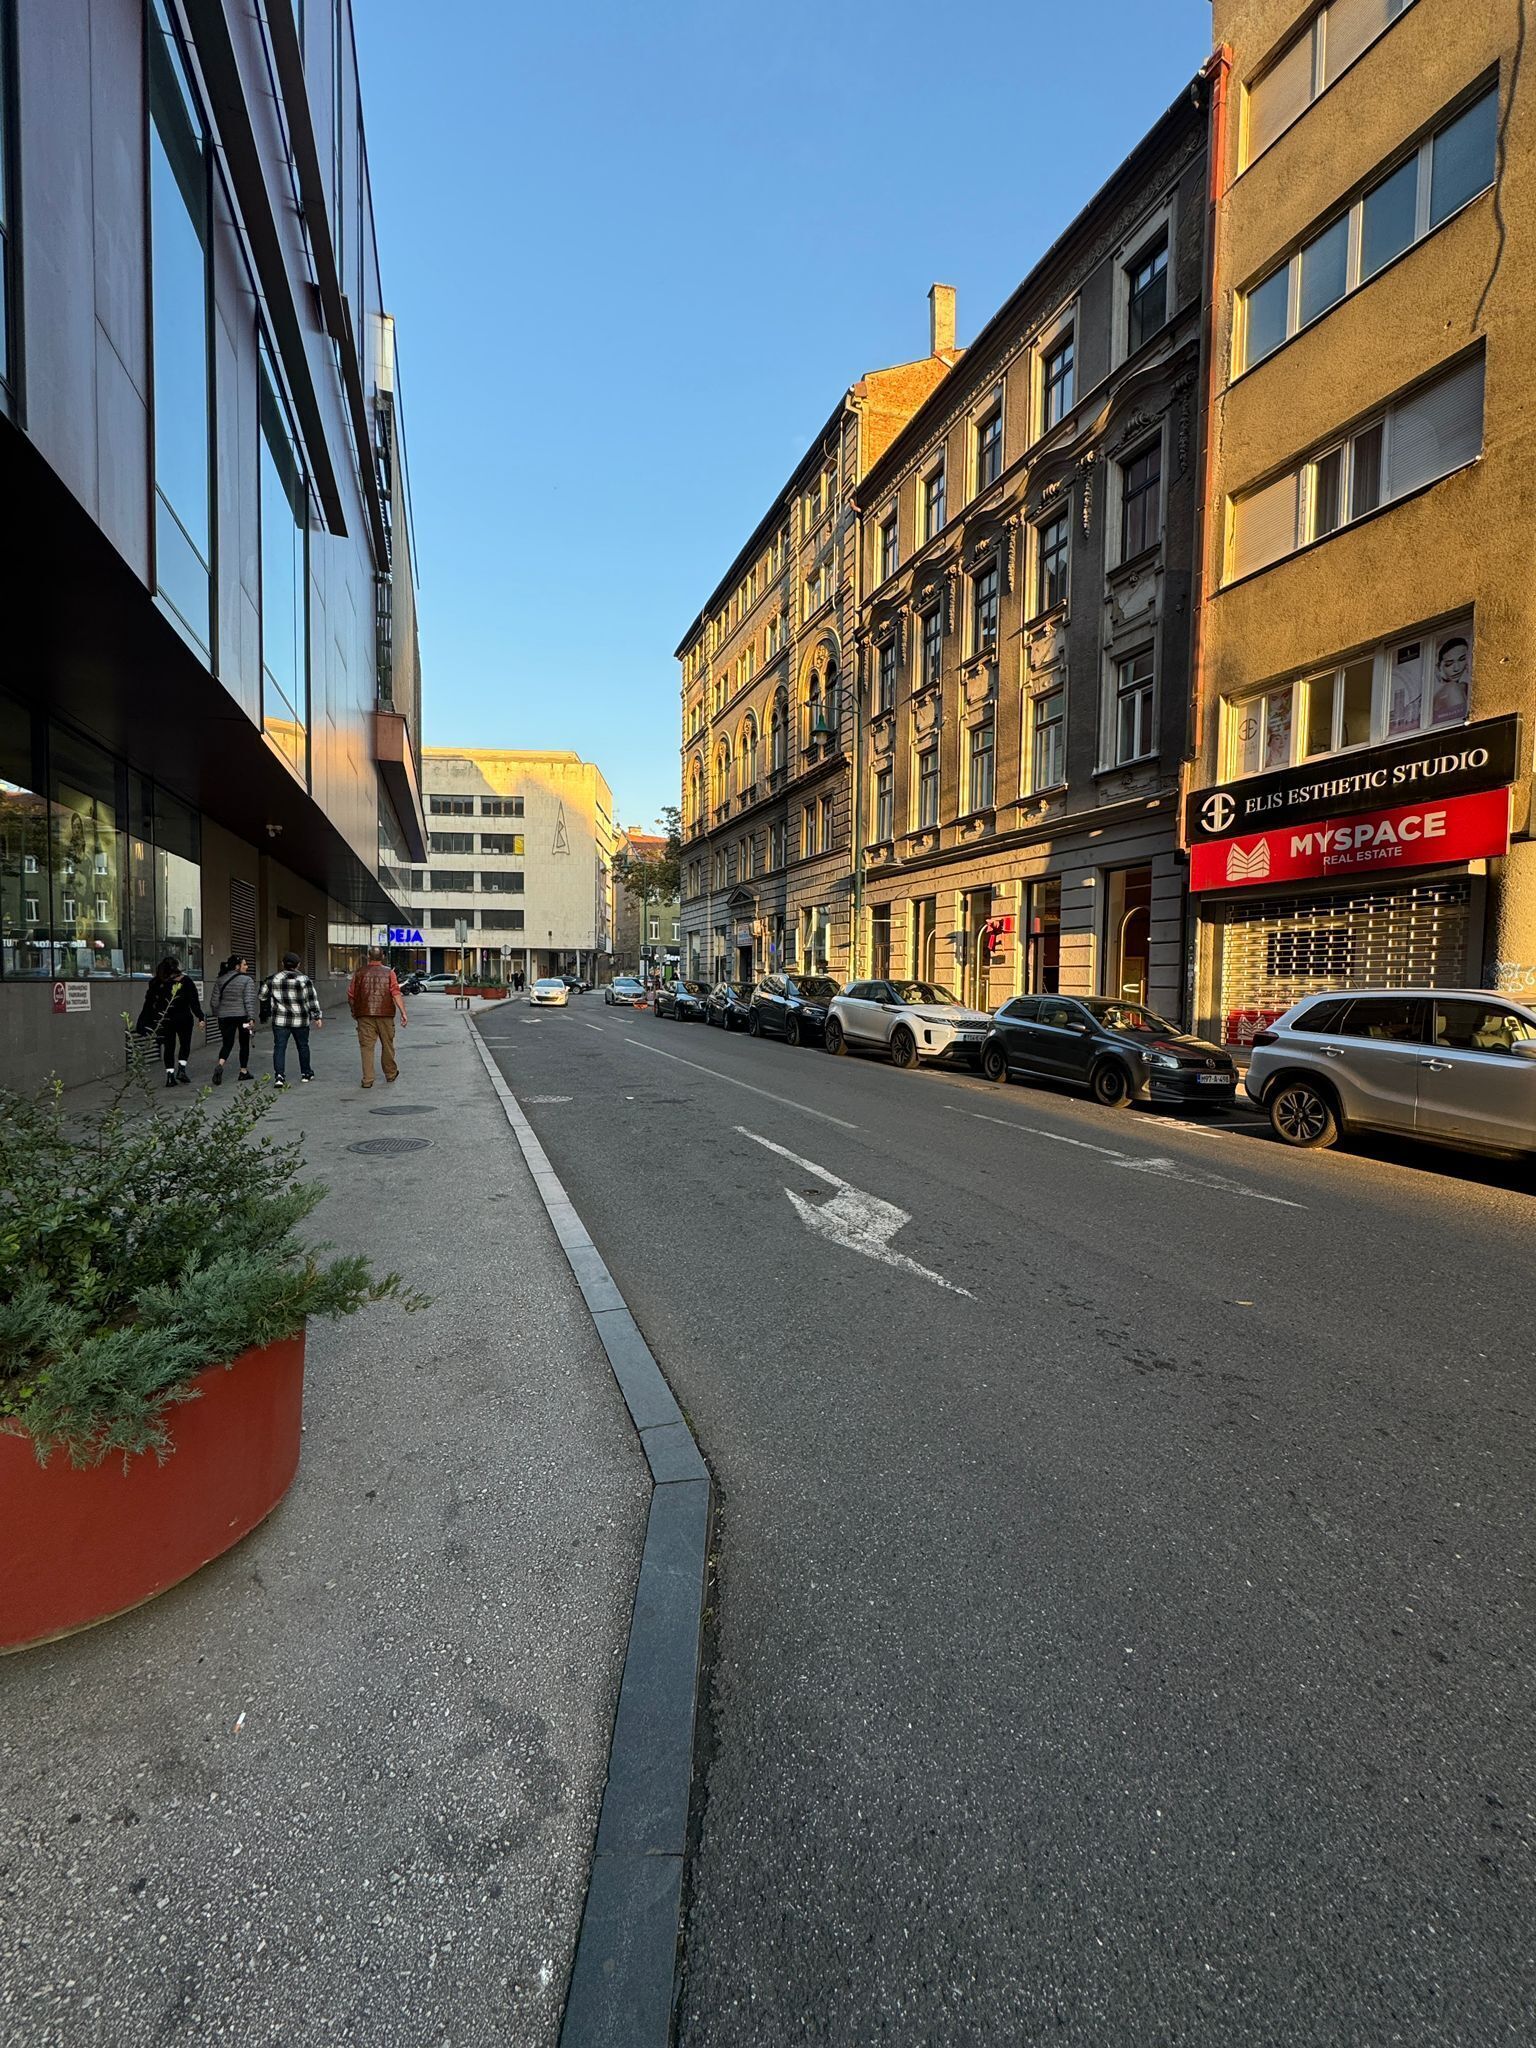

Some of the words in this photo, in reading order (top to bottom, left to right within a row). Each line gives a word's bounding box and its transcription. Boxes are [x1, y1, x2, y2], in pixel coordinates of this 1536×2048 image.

[1245, 791, 1283, 814] ELIS
[1287, 769, 1387, 805] ESTHETIC
[1392, 748, 1489, 784] STUDIO
[1290, 811, 1447, 858] MYSPACE
[1323, 851, 1354, 866] REAL
[1356, 846, 1402, 862] ESTATE
